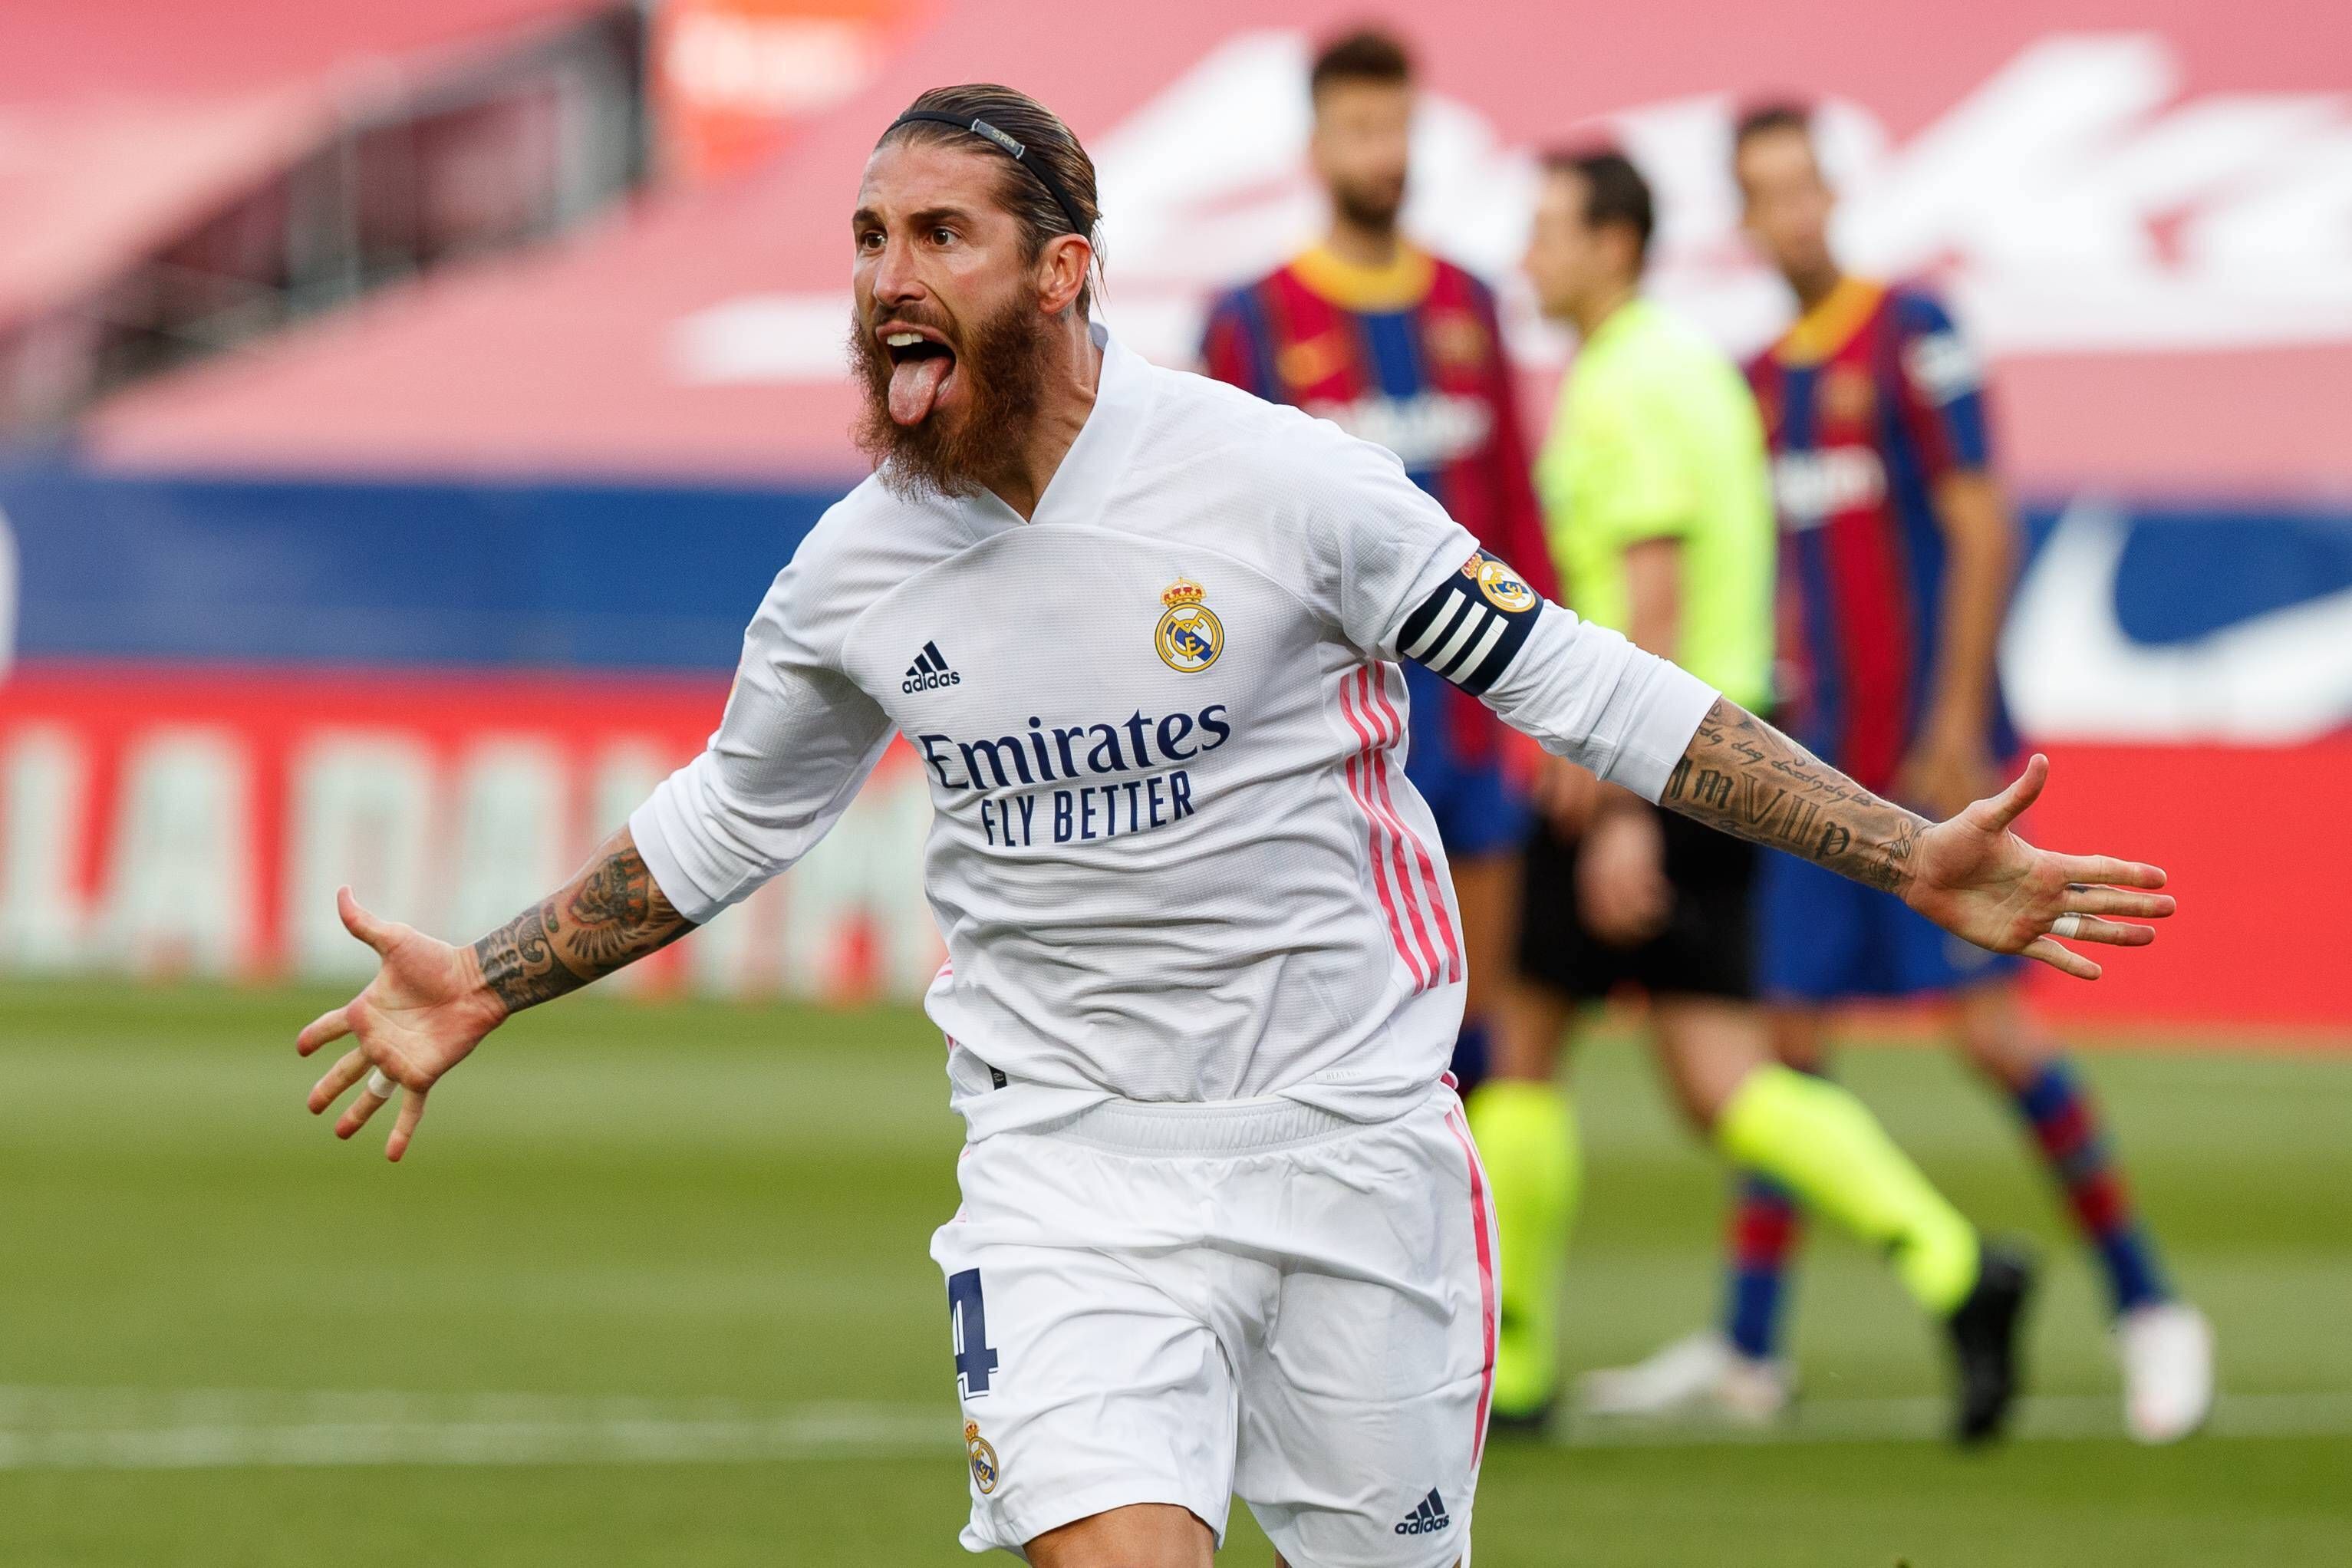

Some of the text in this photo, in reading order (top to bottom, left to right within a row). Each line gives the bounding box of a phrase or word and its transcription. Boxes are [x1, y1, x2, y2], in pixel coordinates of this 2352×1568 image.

[902, 671, 960, 694] adidas
[918, 703, 1230, 790] Emirates
[981, 770, 1194, 846] FLY BETTER
[949, 1267, 998, 1401] 4
[1395, 1515, 1449, 1535] adidas
